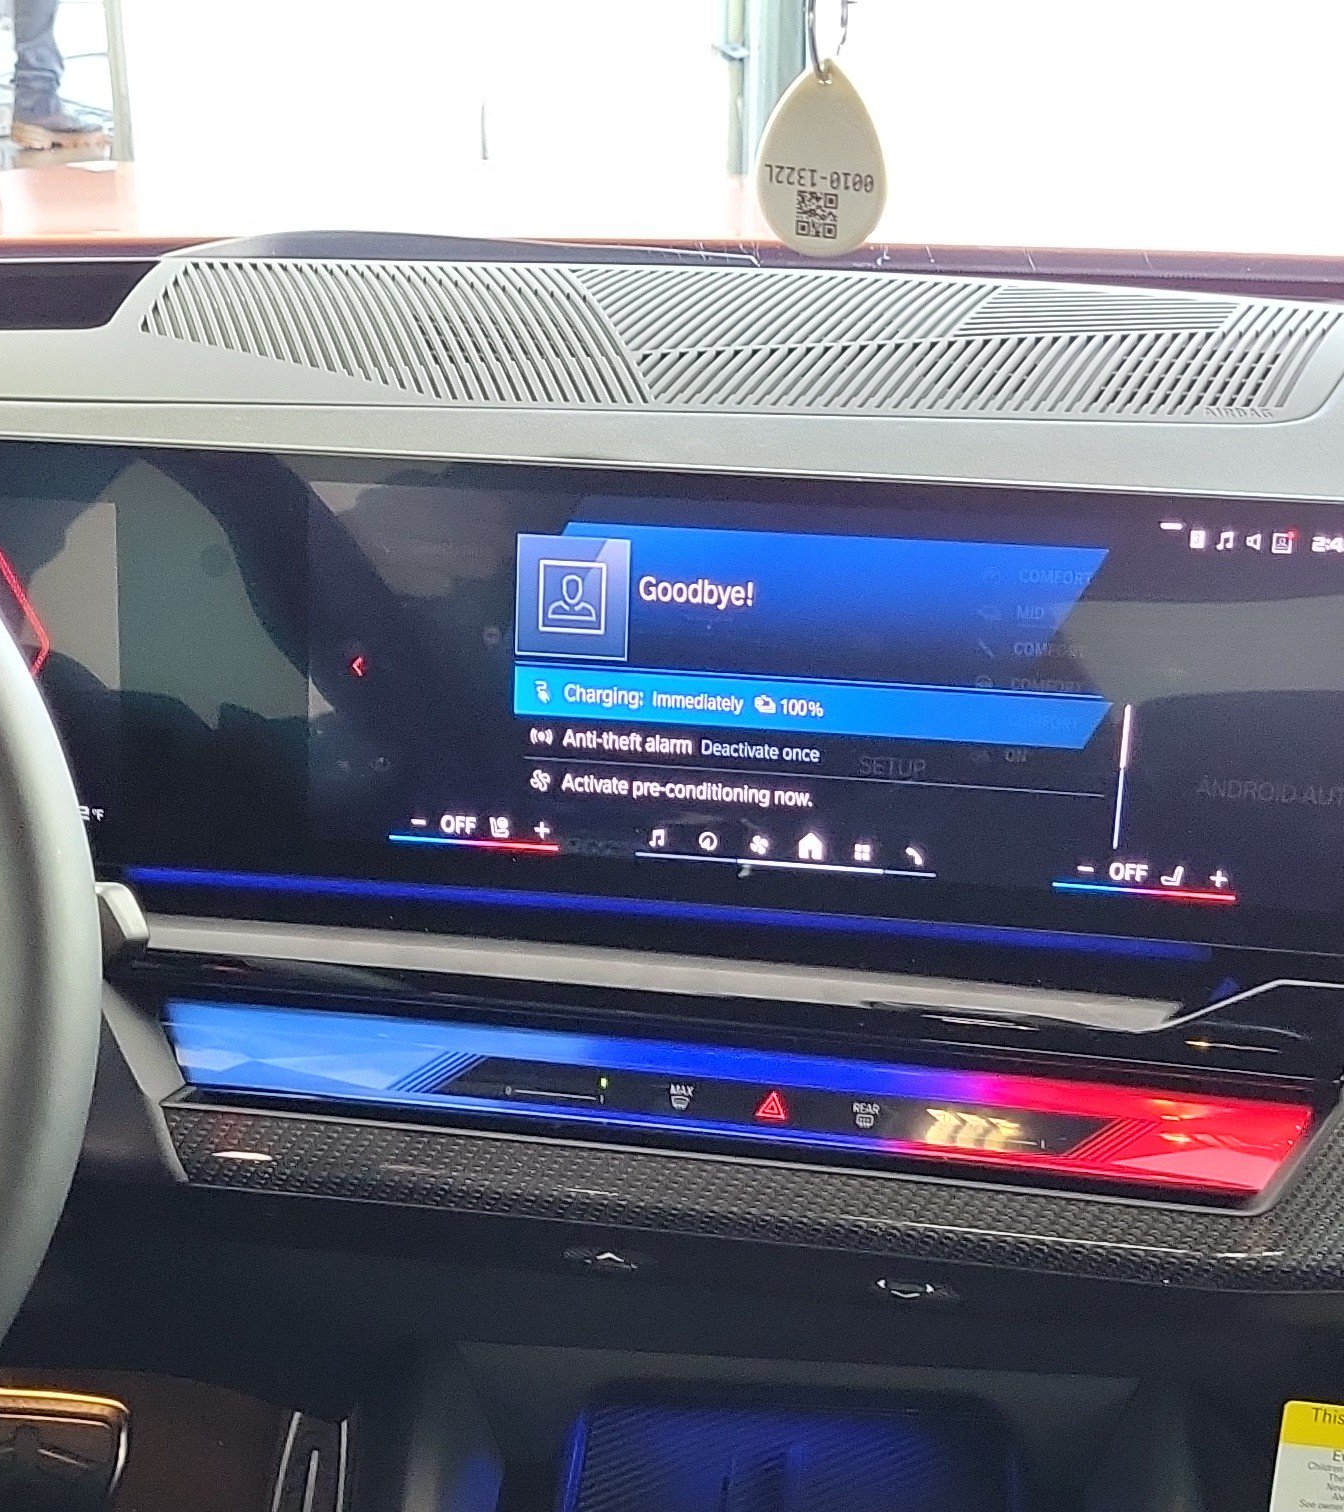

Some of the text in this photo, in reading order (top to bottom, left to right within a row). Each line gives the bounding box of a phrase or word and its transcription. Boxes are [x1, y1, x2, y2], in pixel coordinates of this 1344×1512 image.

[639, 576, 754, 611] Goodbye!
[564, 684, 824, 718] Charging: Immediately 100%
[562, 728, 821, 763] Anti-theft alarm Deactivate once
[561, 772, 814, 808] Activate pre-conditioning now.
[440, 814, 477, 835] OFF
[1109, 862, 1149, 882] OFF
